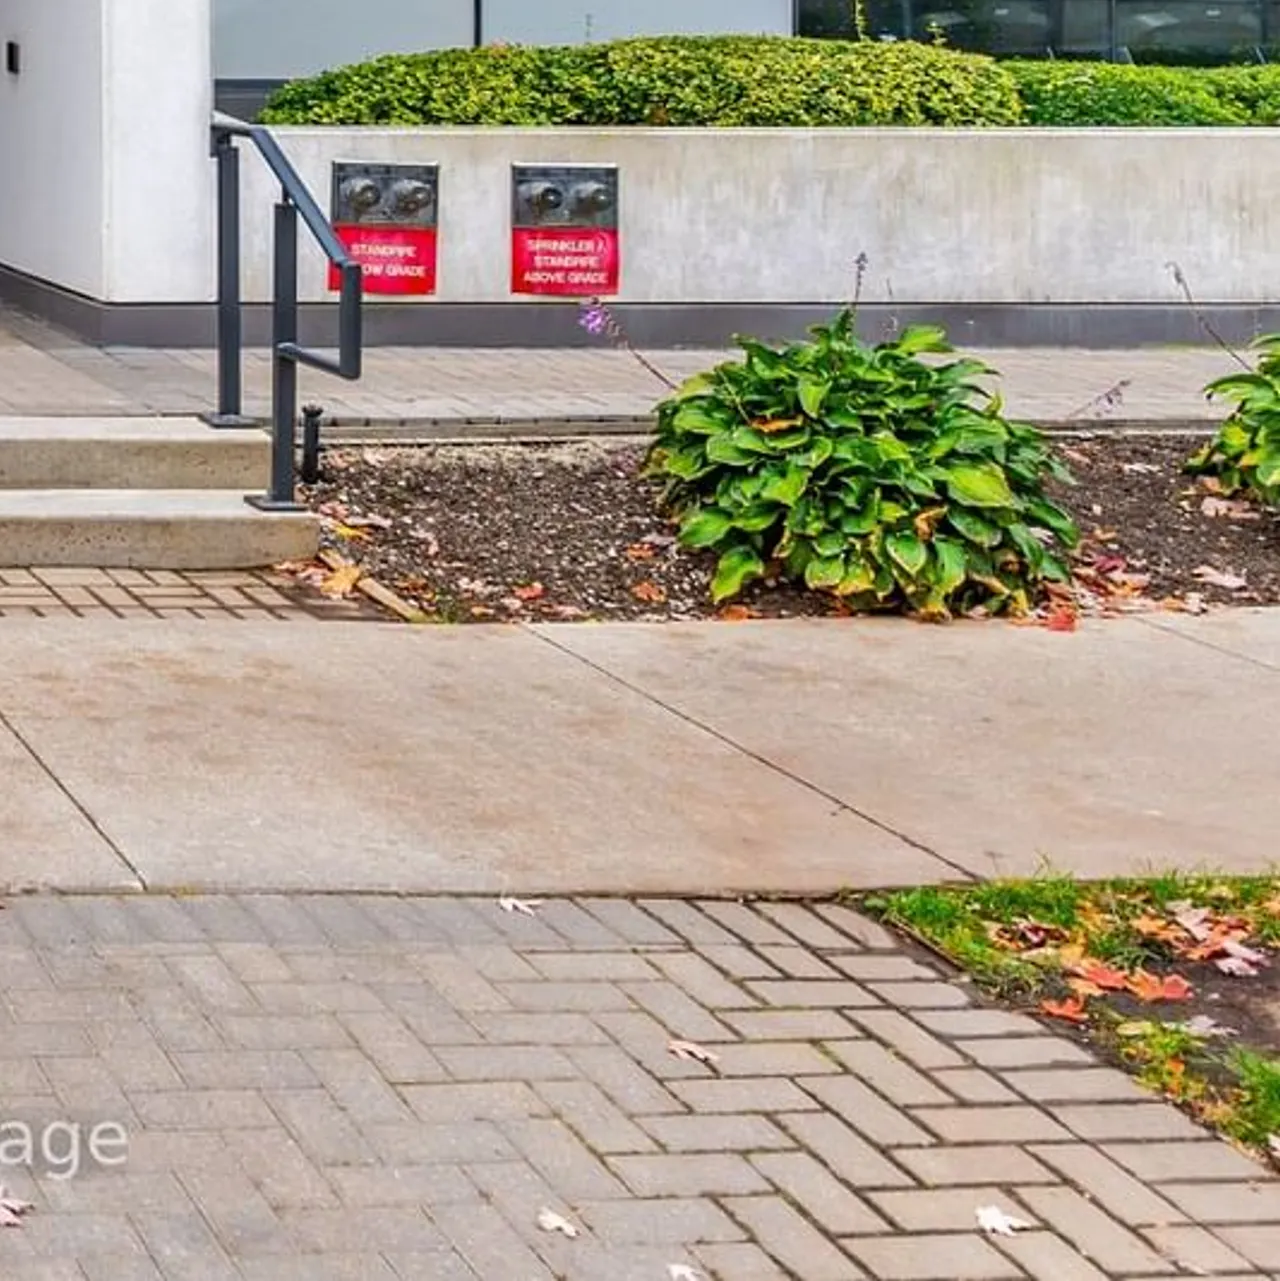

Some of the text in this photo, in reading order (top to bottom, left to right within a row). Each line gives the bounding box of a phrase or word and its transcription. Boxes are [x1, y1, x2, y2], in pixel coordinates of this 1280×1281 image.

[385, 264, 426, 277] GRADE
[524, 272, 608, 284] ABOVE GRADE
